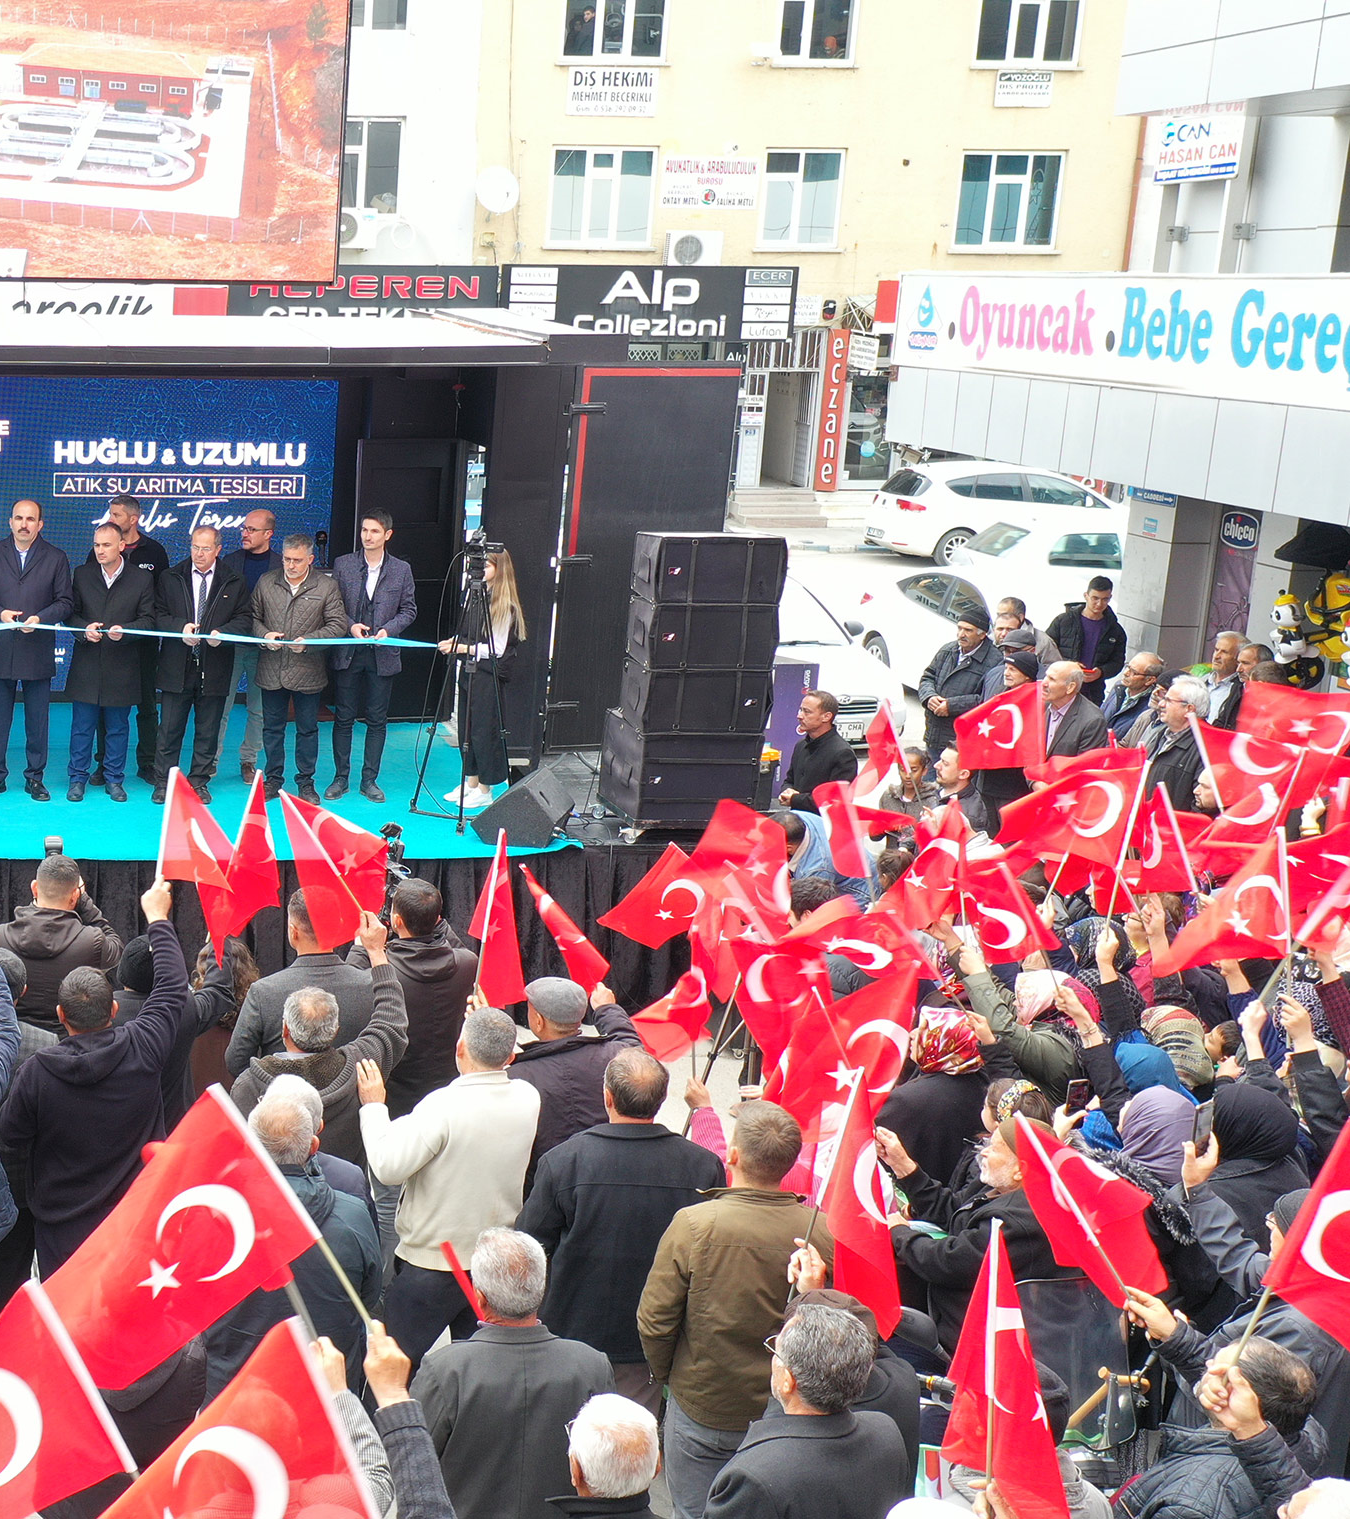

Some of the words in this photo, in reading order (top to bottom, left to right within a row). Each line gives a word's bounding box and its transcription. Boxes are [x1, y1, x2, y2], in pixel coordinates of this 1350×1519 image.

[572, 91, 607, 102] MEHMET
[1159, 146, 1204, 165] HASAN
[1210, 142, 1237, 160] CAN
[665, 160, 700, 174] AVUKATLIK
[662, 196, 681, 205] OKTAY
[752, 271, 788, 280] ECER
[600, 269, 700, 312] Alp
[959, 285, 1096, 360] Oyuncak
[1118, 286, 1213, 364] Bebe
[820, 337, 845, 483] eczane
[54, 438, 156, 465] HUĞLU
[161, 448, 176, 465] &
[62, 477, 103, 493] ATIK
[107, 477, 131, 493] SU
[135, 477, 205, 494] ARITMA
[210, 476, 297, 495] TESİSLERİ
[1224, 516, 1255, 541] chicco
